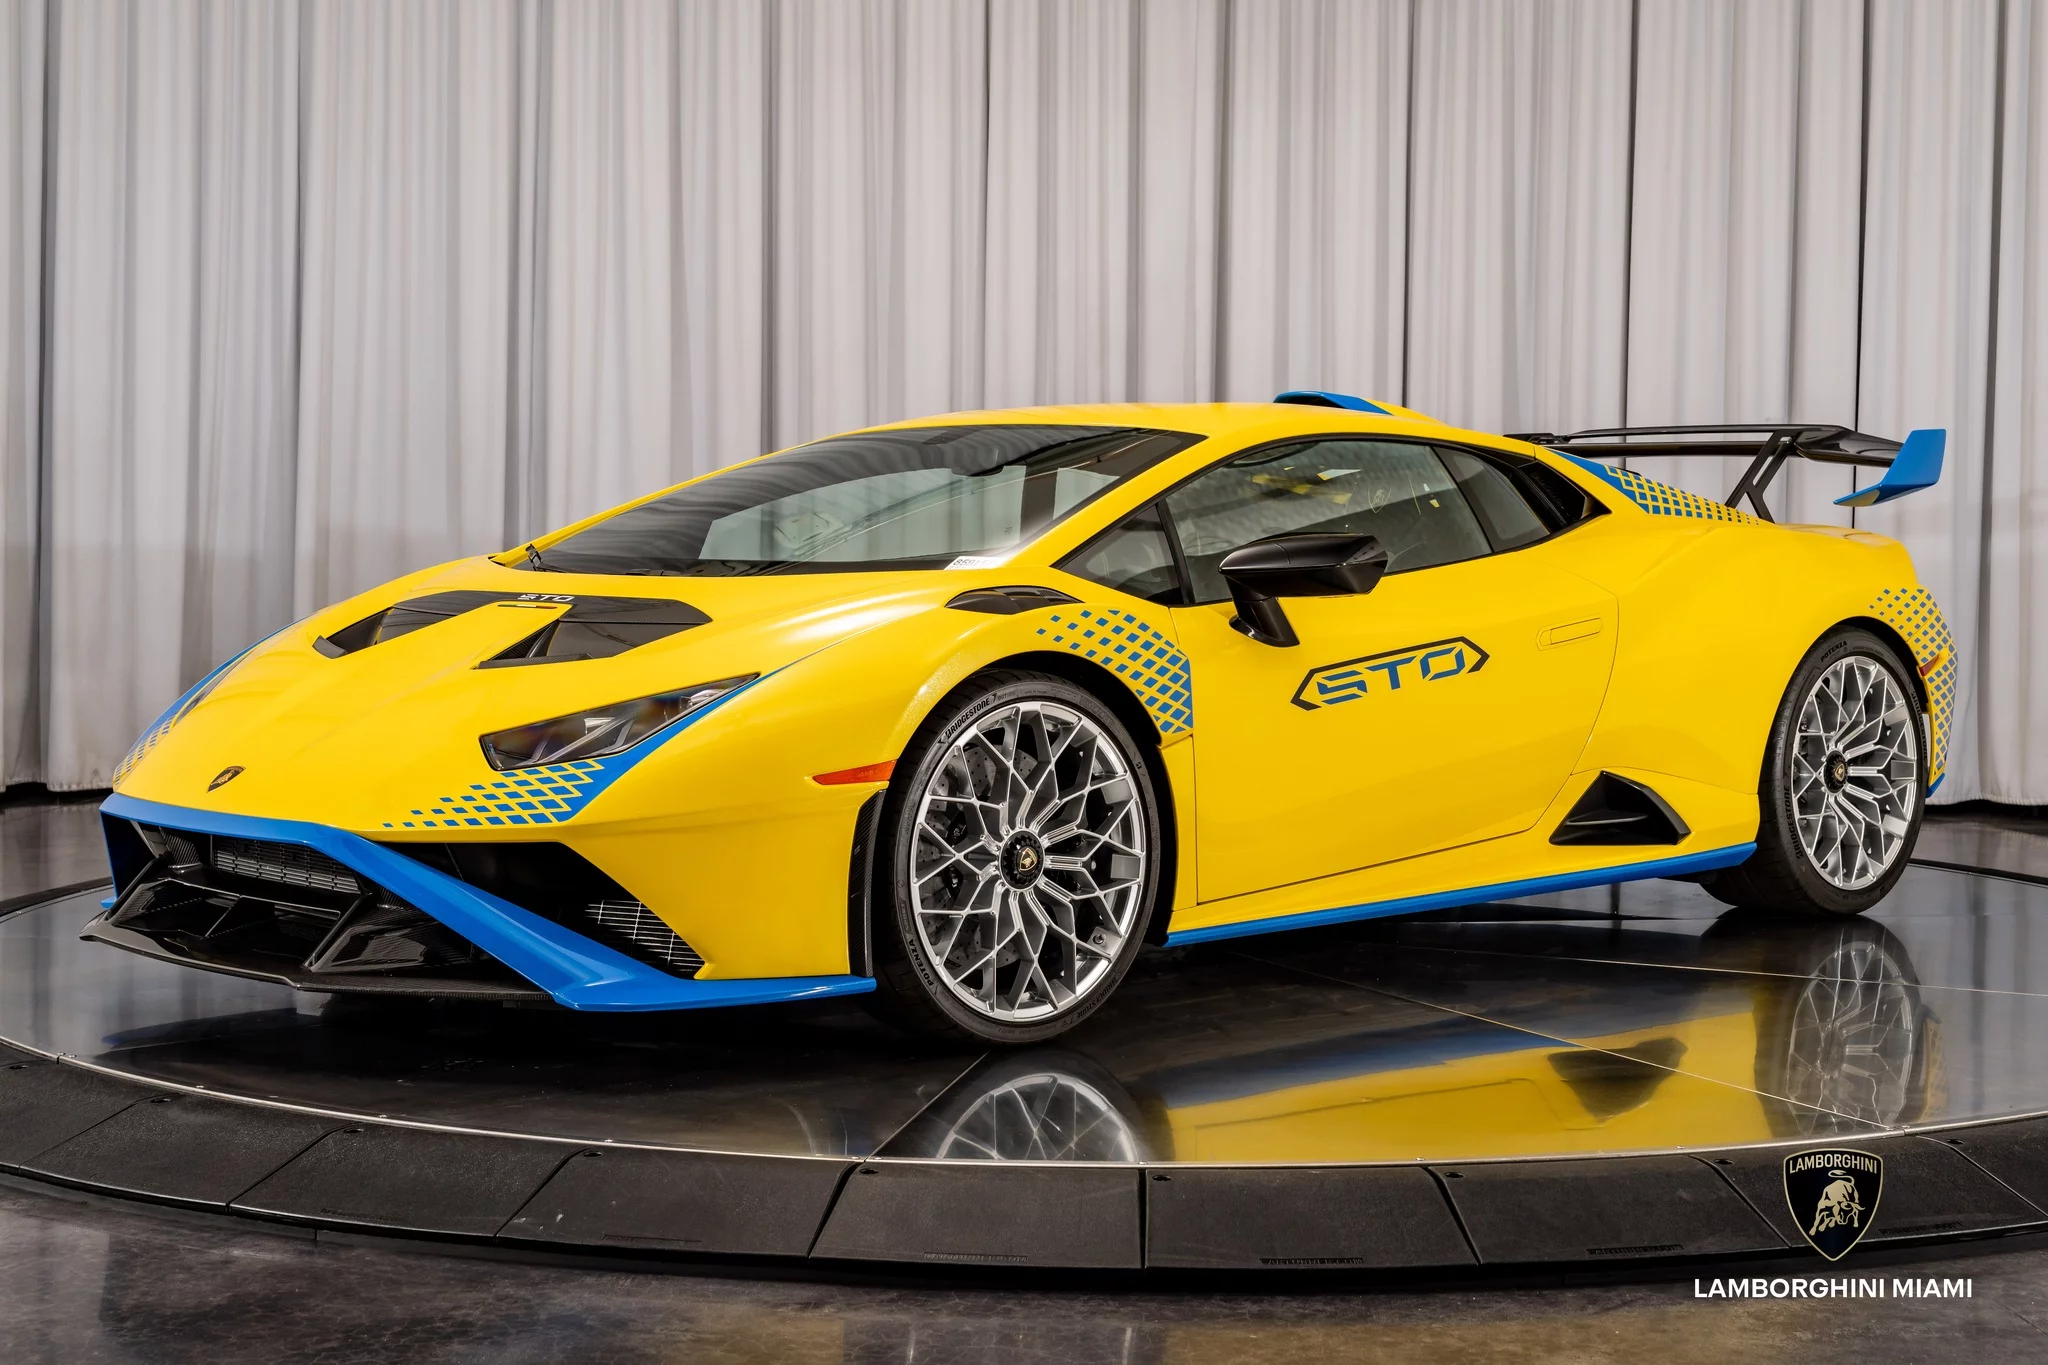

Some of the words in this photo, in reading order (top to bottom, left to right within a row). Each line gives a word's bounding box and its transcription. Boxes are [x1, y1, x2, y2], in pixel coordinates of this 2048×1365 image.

[517, 593, 576, 602] STO
[1820, 640, 1848, 662] POTENZA
[1316, 646, 1466, 705] STO
[944, 697, 991, 741] BRIDGESTONE
[1783, 784, 1804, 860] BRIDGESTONE
[908, 938, 935, 987] POTENZA
